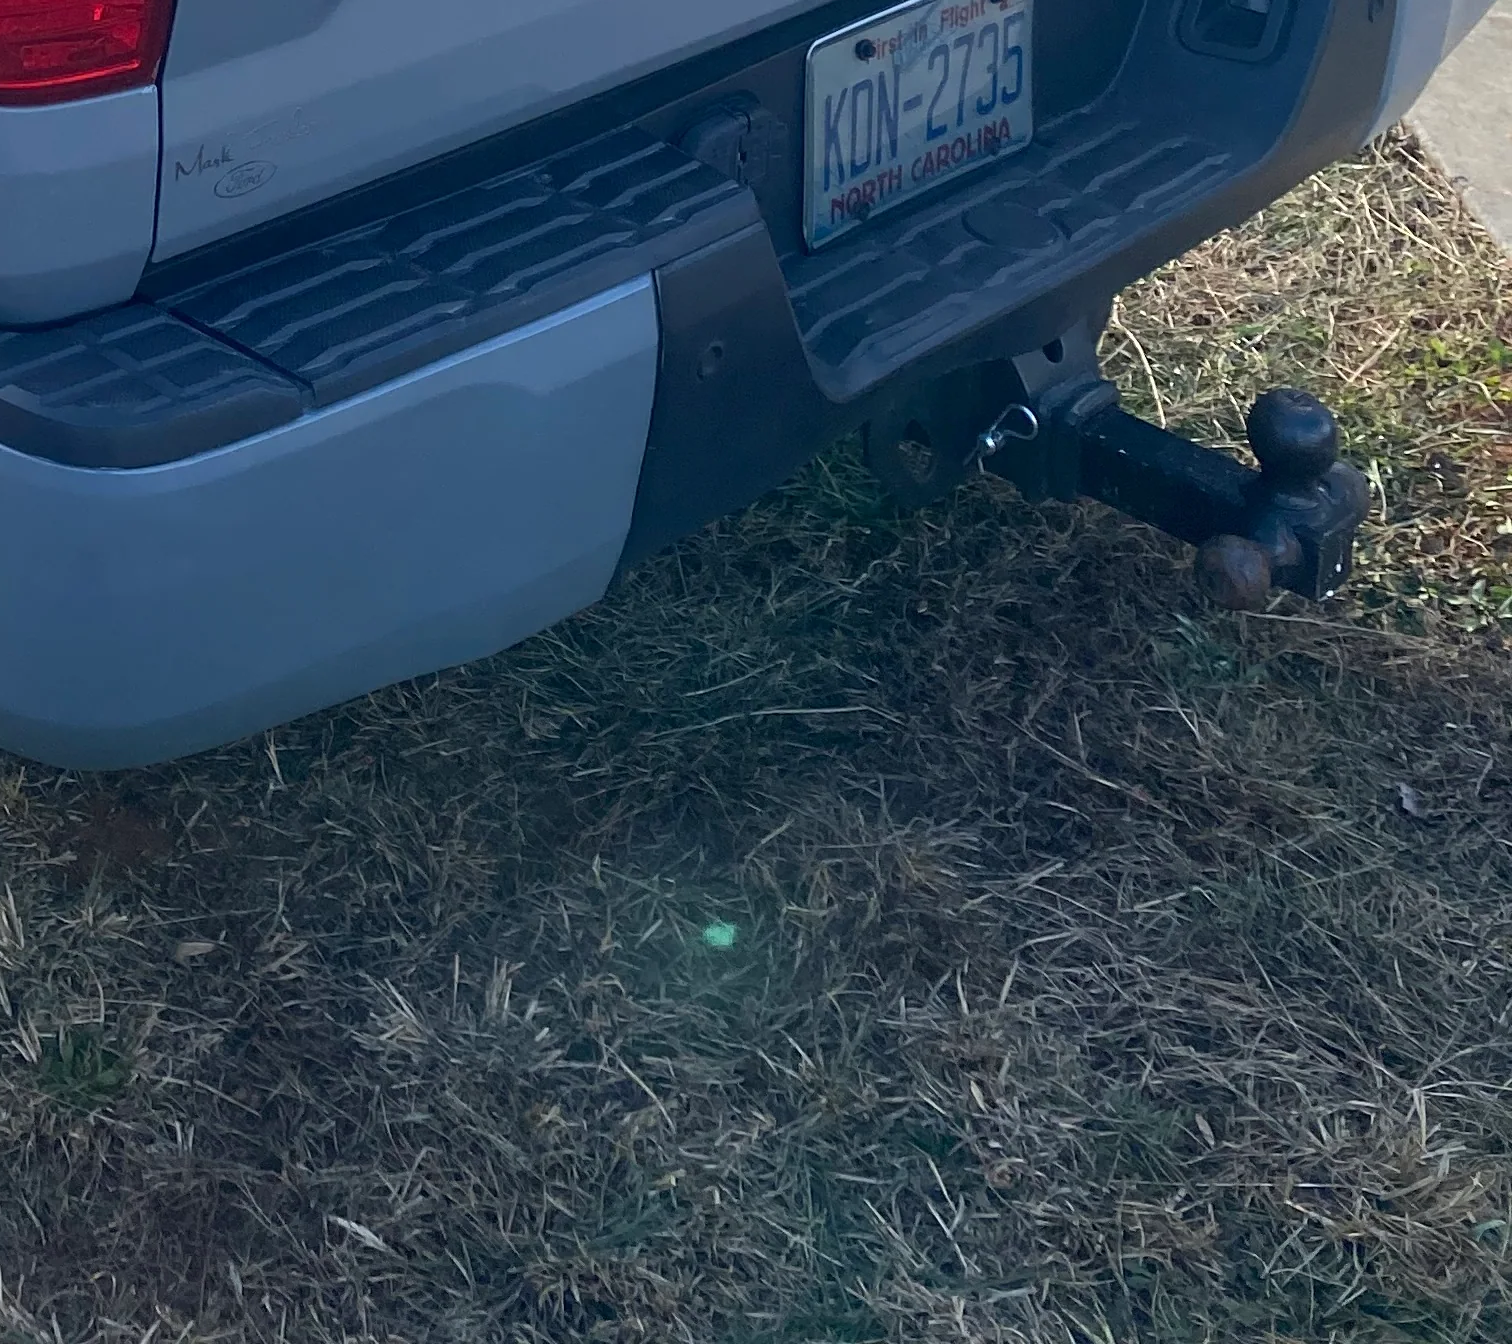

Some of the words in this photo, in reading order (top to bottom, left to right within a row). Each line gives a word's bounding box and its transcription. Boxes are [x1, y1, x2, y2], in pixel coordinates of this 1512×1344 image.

[823, 12, 1024, 193] KDN-2735
[830, 164, 903, 226] NORTH
[909, 115, 1012, 183] CAROLINA
